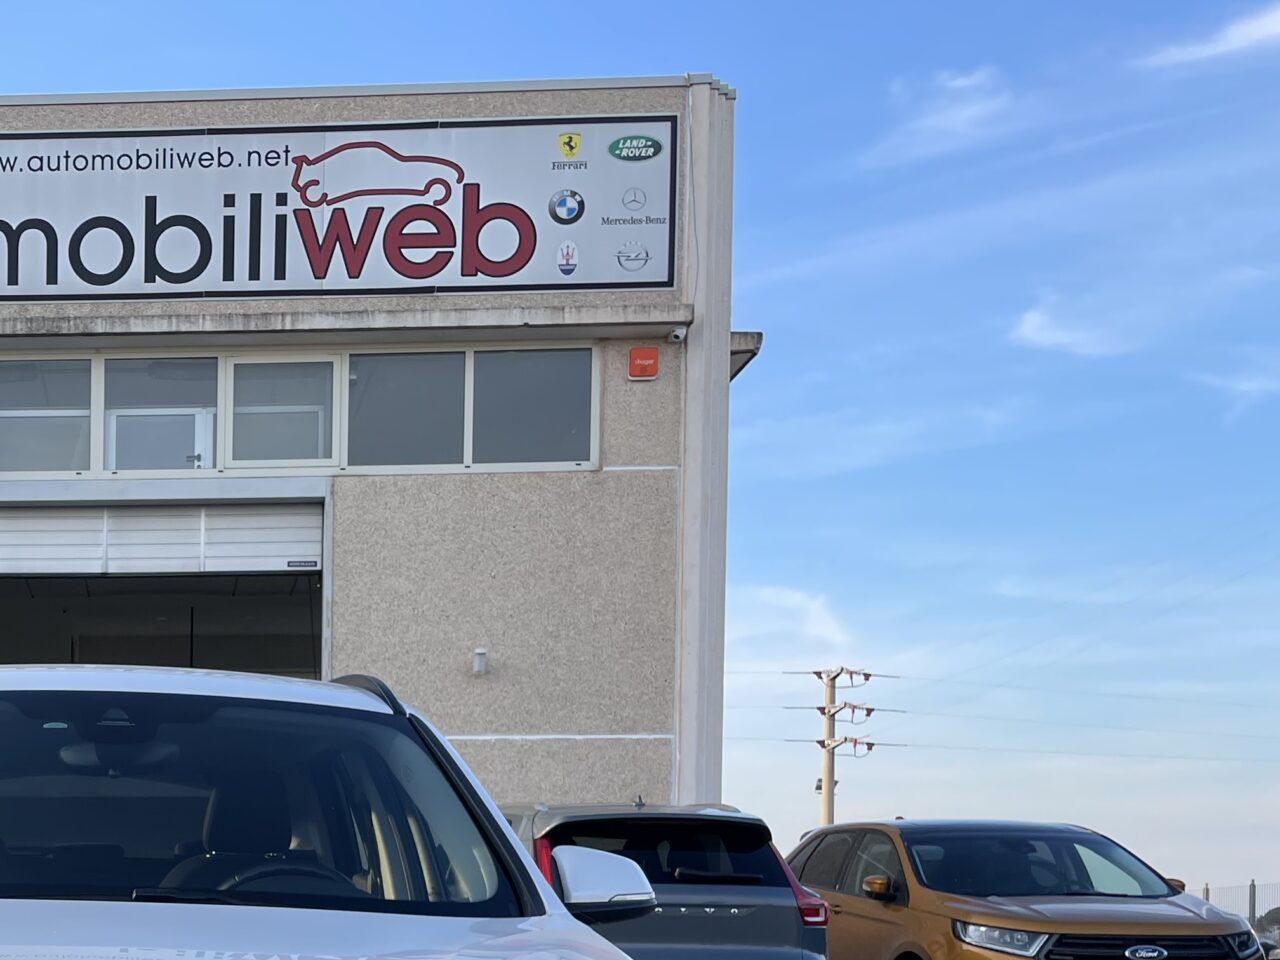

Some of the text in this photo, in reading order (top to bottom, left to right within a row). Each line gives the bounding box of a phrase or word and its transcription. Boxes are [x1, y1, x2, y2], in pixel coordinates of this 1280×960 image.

[618, 139, 644, 148] LAND
[621, 148, 655, 157] ROVER
[601, 216, 667, 226] Mercedes-Benz
